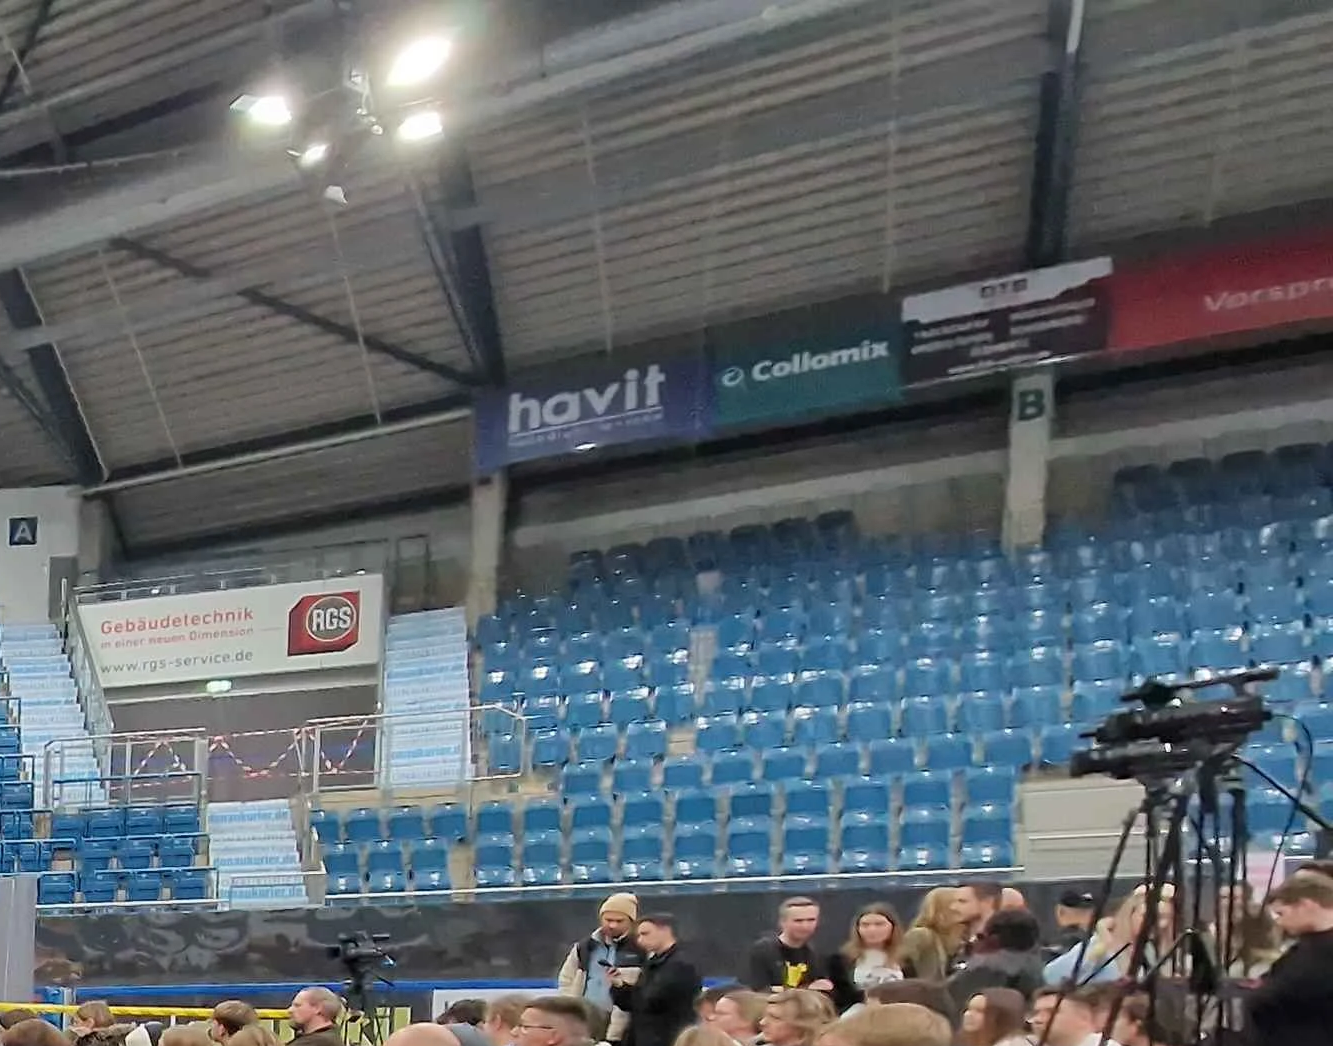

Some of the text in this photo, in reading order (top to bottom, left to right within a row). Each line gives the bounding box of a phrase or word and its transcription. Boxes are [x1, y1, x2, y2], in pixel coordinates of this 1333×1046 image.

[750, 339, 891, 383] Collomix
[508, 363, 667, 434] havit
[1017, 389, 1046, 422] B
[14, 520, 34, 543] A
[100, 607, 255, 635] Gebäudetechnik
[312, 605, 352, 633] RGS
[115, 636, 146, 650] einer
[189, 626, 255, 642] Dimension
[100, 649, 254, 675] www.rgs-service.de
